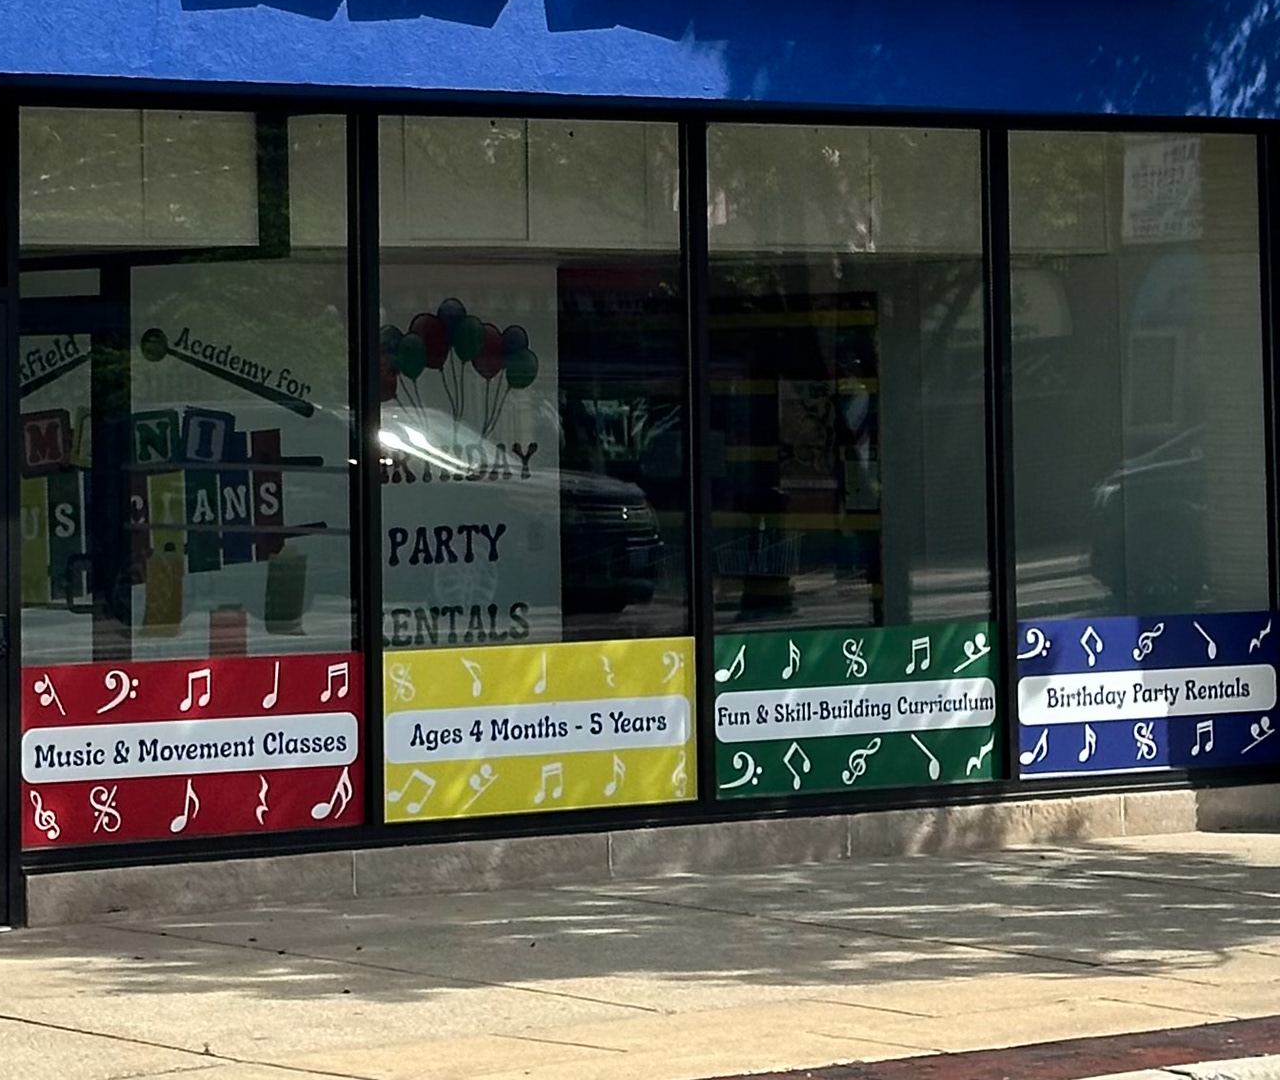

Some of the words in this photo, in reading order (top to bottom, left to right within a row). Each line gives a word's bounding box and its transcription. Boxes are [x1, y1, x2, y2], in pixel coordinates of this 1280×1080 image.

[174, 326, 272, 385] Academy
[275, 368, 312, 399] for
[388, 523, 506, 566] PARTY
[718, 706, 750, 727] Fun
[755, 704, 770, 725] &
[773, 698, 892, 725] Skill-Building
[896, 692, 995, 717] Curriculum
[1046, 684, 1125, 709] Birthday
[1132, 682, 1180, 707] Party
[1184, 678, 1251, 702] Rentals
[409, 721, 463, 748] Ages
[468, 719, 484, 744] 4
[490, 714, 569, 742] Months
[589, 713, 603, 736] 5
[608, 710, 668, 735] Years
[34, 741, 106, 769] Music
[113, 740, 131, 766] &
[138, 734, 256, 764] Movement
[262, 729, 348, 758] Classes
